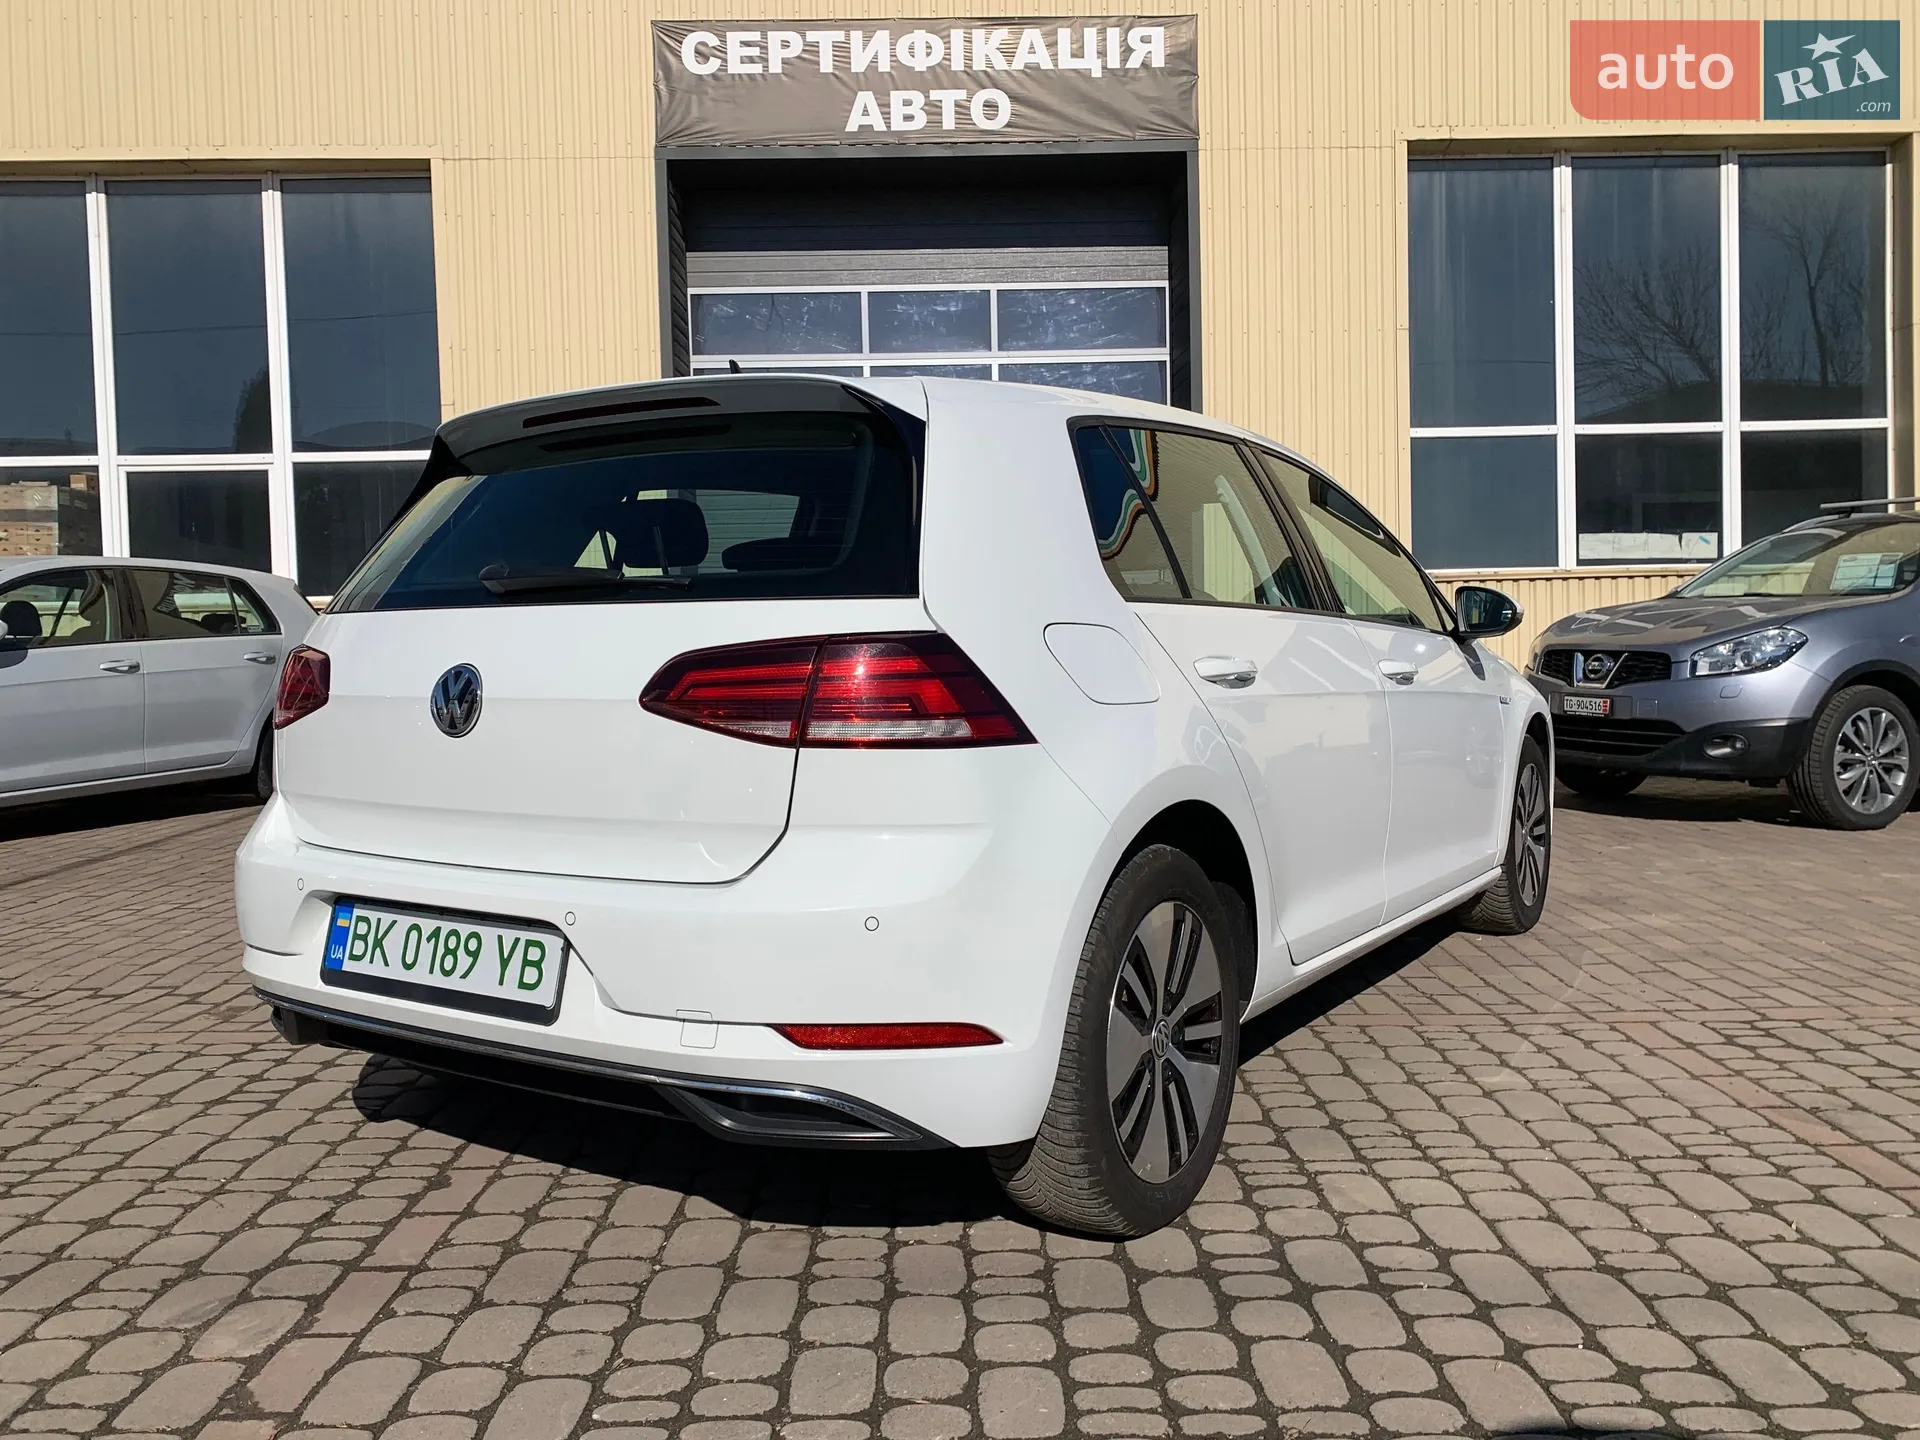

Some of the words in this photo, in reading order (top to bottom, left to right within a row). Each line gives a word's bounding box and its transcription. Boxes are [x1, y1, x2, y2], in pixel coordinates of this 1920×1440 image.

[681, 26, 1166, 78] СЕРТИФІКАЦІЯ
[844, 88, 1012, 132] АВТО
[330, 943, 343, 960] UA
[347, 914, 398, 968] BK
[401, 923, 483, 980] 0189
[496, 934, 547, 992] YB
